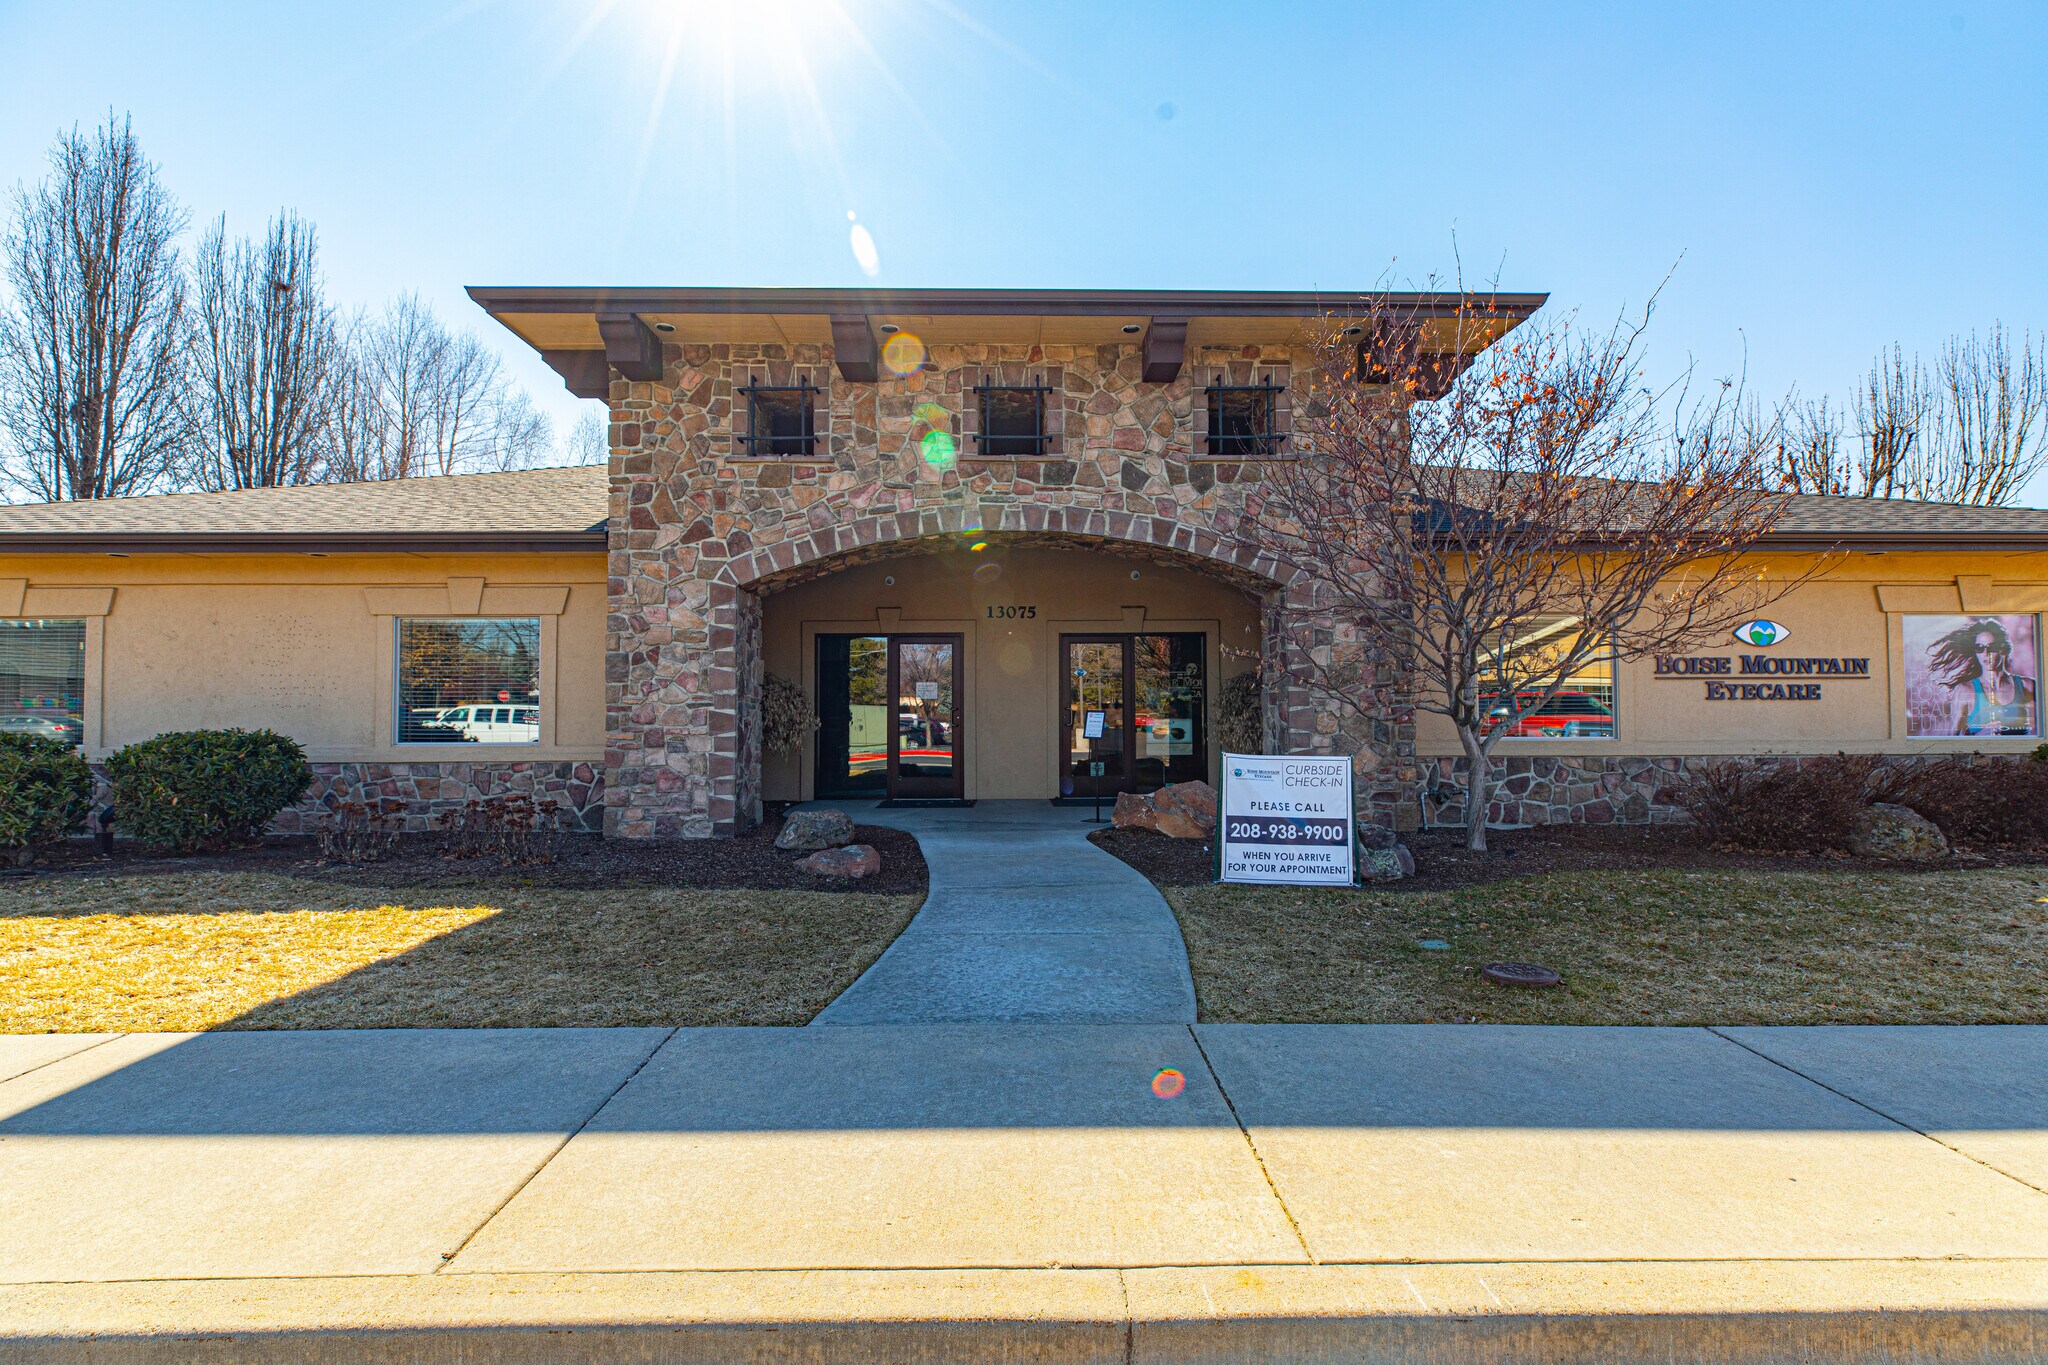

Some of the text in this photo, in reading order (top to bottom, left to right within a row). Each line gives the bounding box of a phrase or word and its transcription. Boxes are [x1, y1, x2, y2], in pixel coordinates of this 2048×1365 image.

[986, 606, 1036, 619] 13075
[1654, 654, 1870, 674] BOISE MOUNTAIN
[1705, 680, 1822, 700] EYECARE
[1285, 764, 1342, 776] CURBSIDE
[1285, 776, 1343, 787] CHECK-IN
[1250, 801, 1325, 812] PLEASE CALL
[1230, 823, 1343, 840] 208-938-9900
[1242, 851, 1331, 862] WHEN YOU ARRIVE
[1228, 863, 1346, 874] FOR YOUR APPOINTMENT
